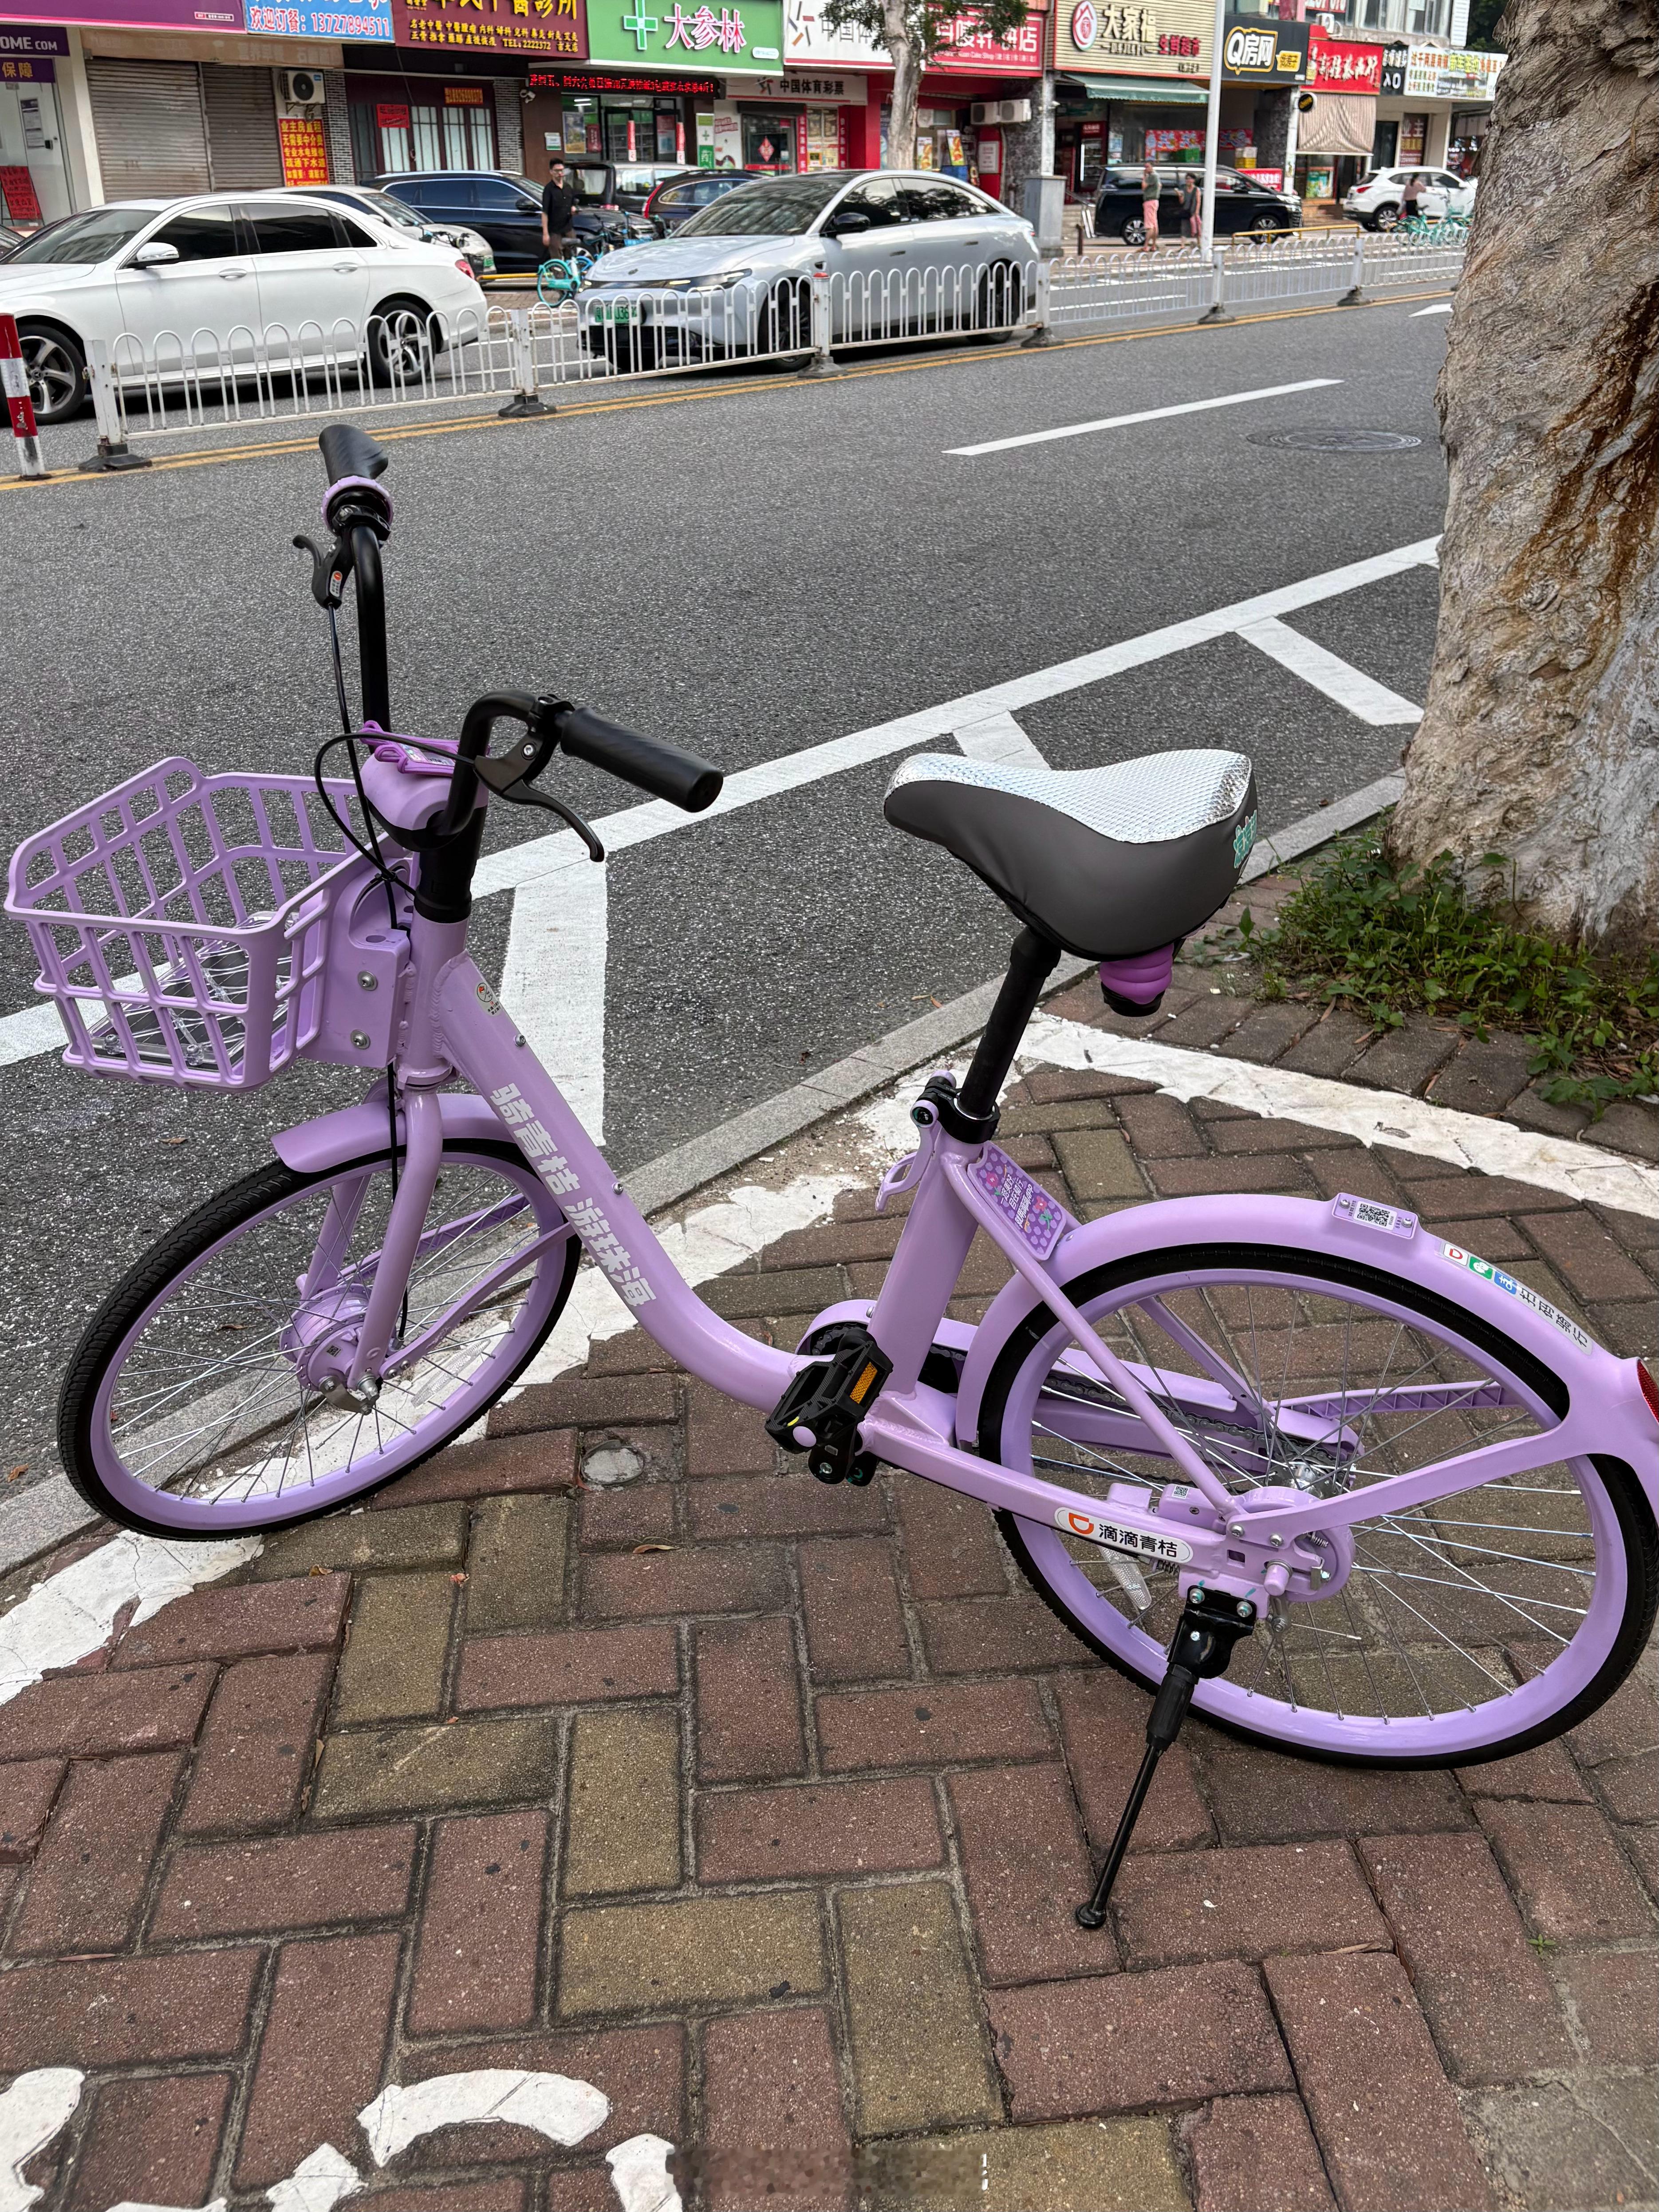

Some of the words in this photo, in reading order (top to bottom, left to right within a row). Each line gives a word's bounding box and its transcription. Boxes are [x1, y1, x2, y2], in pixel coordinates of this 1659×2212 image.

[664, 3, 747, 53] 大参林
[1102, 4, 1157, 42] 大家福
[35, 41, 58, 51] COM
[1227, 32, 1275, 66] Q房网
[2, 62, 33, 78] 保障
[780, 79, 844, 95] 中国体育彩票
[490, 1083, 580, 1195] 骑青桔
[564, 1197, 656, 1307] 游珠海
[1519, 1289, 1588, 1347] 扫码骑行
[1099, 1523, 1178, 1558] 滴滴青桔
